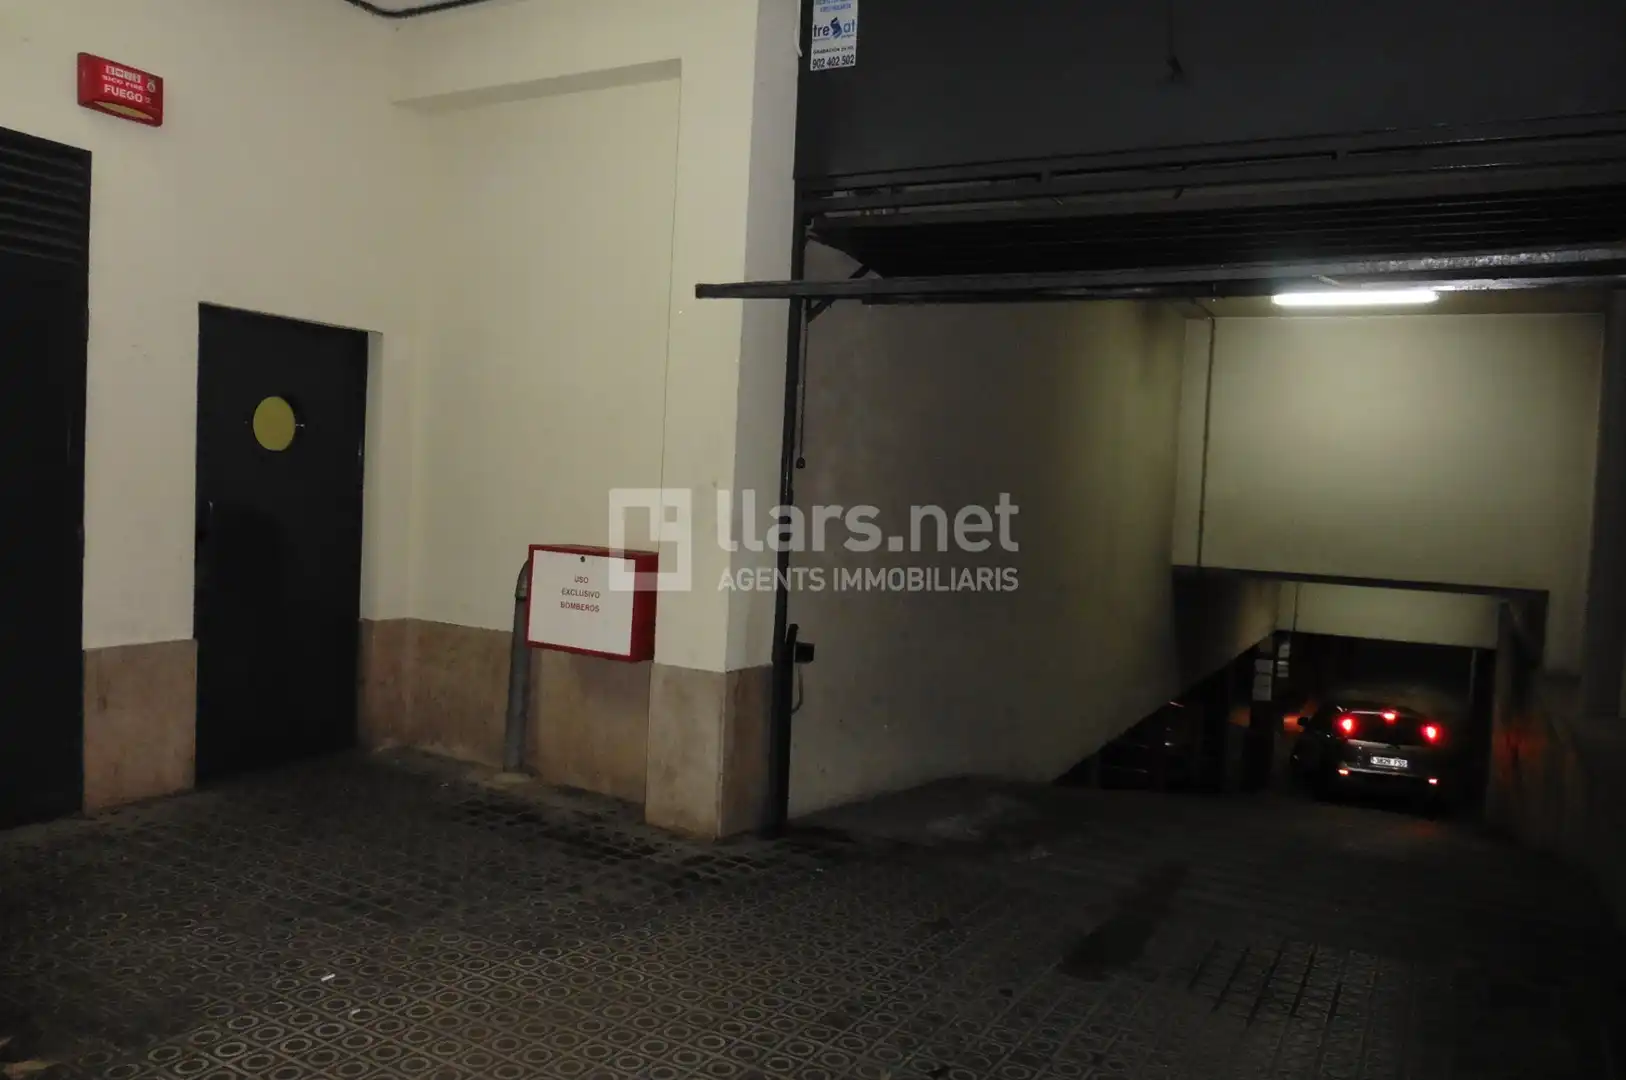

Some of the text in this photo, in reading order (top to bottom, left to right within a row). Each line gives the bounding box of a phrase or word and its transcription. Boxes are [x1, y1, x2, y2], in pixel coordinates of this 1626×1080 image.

[813, 54, 855, 69] 902 402 502
[104, 84, 143, 103] FUEGO
[561, 588, 600, 599] EXCLUSIVO
[560, 601, 600, 612] BOMBEROS
